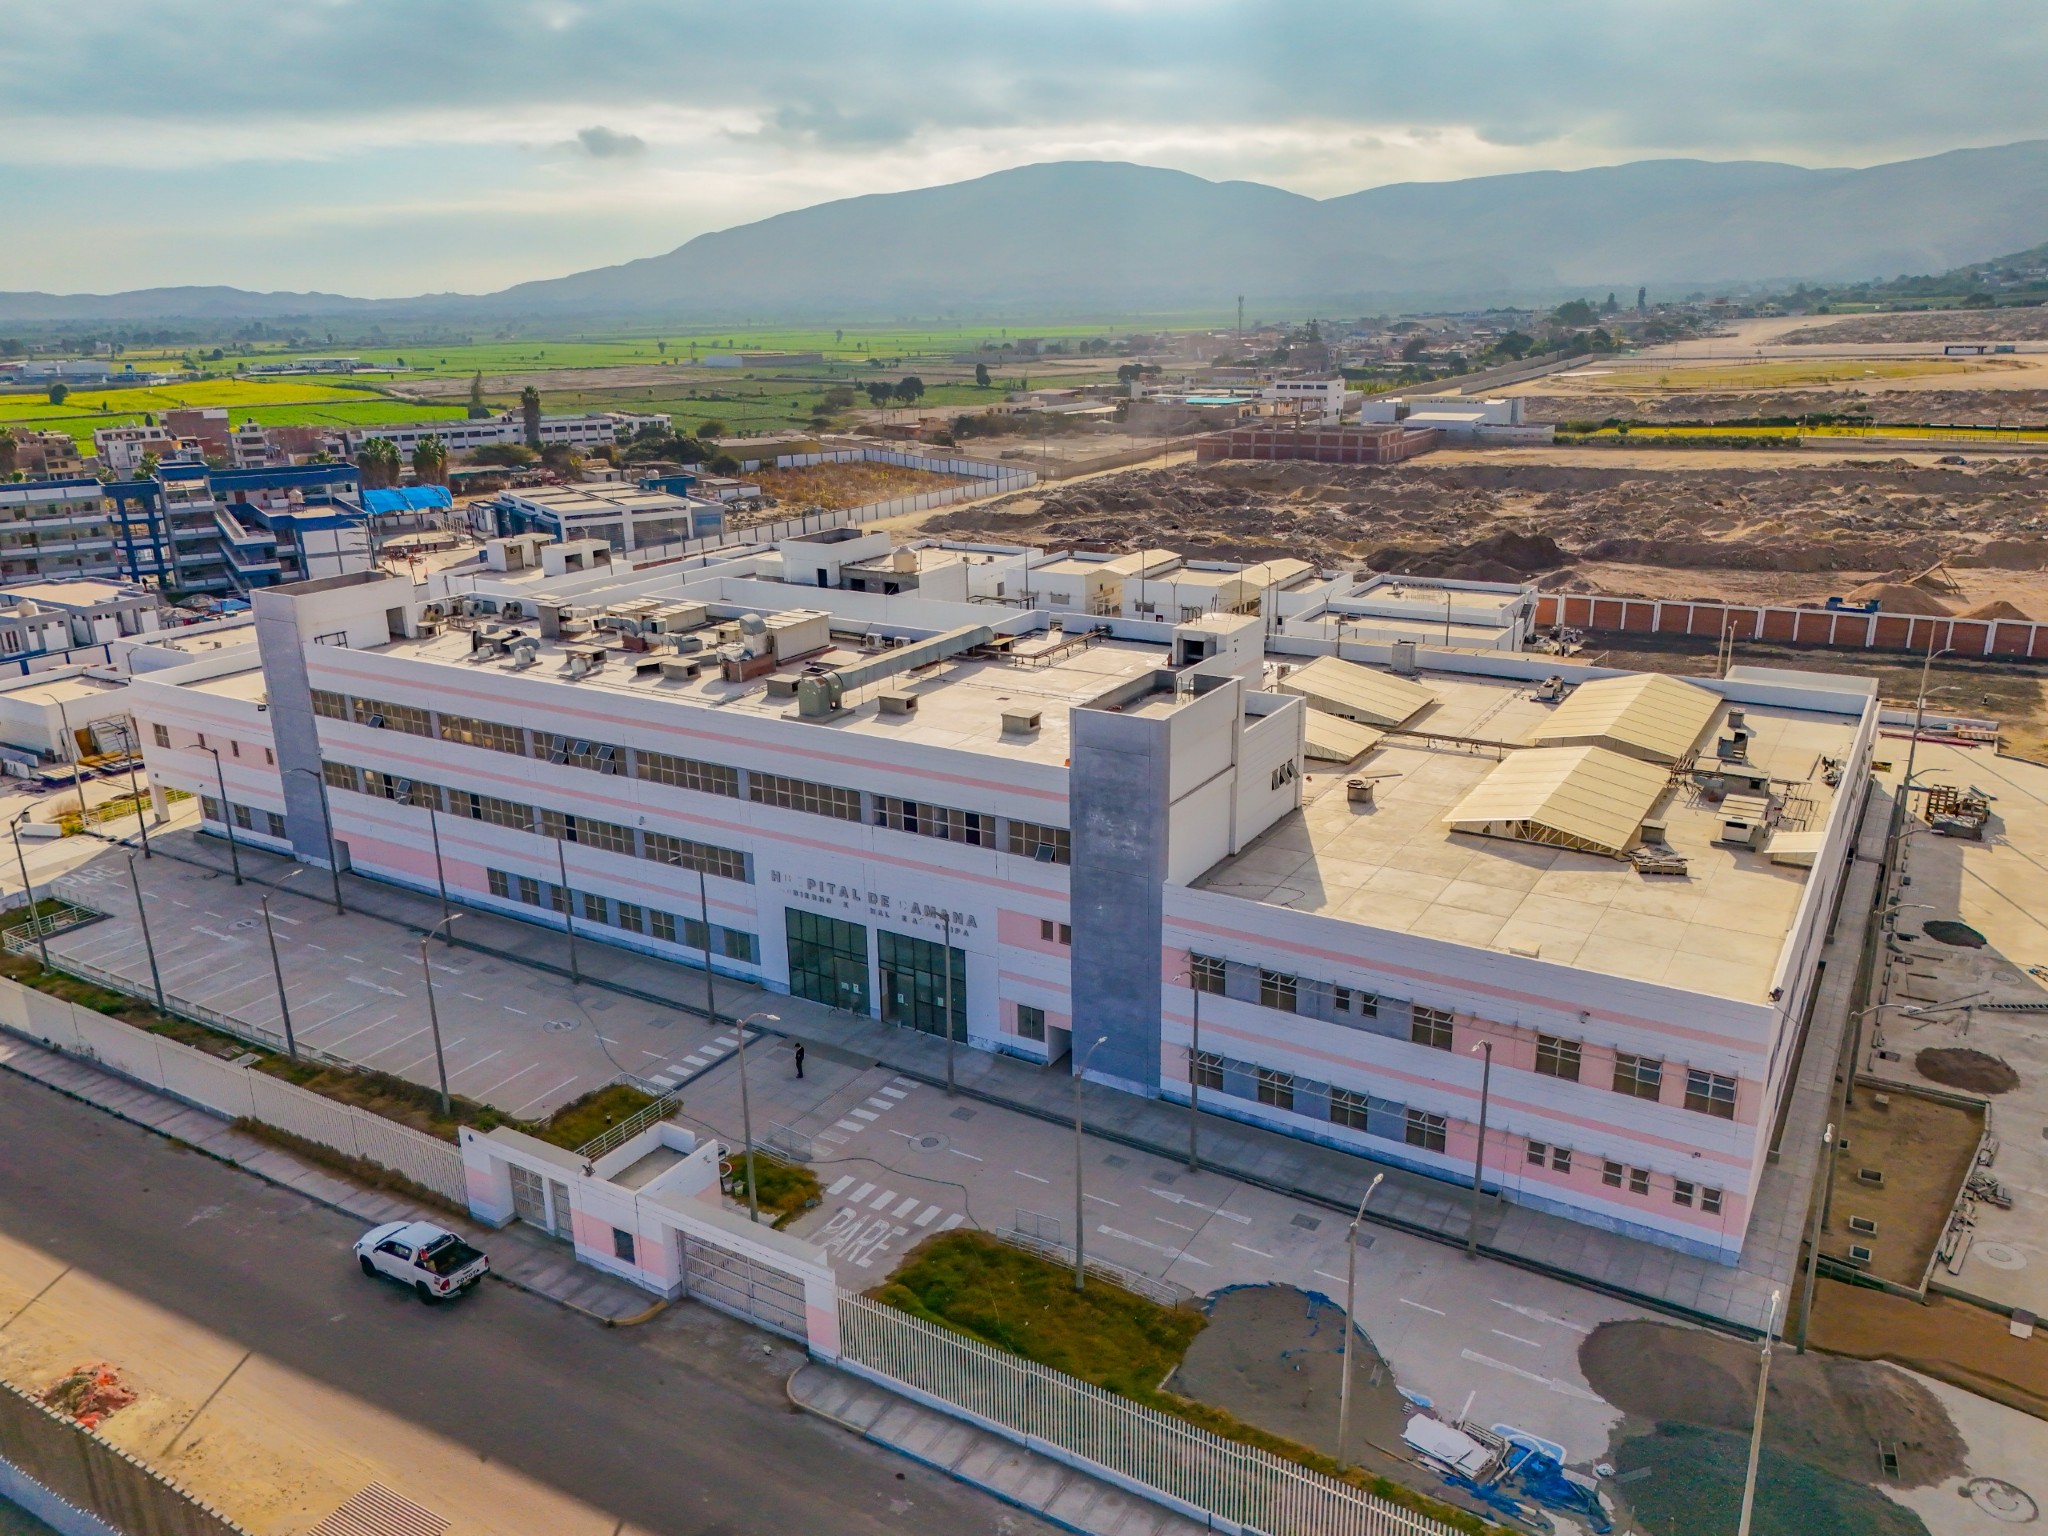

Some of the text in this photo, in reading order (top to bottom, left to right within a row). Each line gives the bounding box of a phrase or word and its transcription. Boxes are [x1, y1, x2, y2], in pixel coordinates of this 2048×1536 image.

[56, 864, 126, 888] PARE
[771, 869, 861, 902] HPITAL
[867, 891, 890, 908] DE
[806, 1207, 909, 1269] PARE
[456, 1268, 480, 1285] TOYOTA
